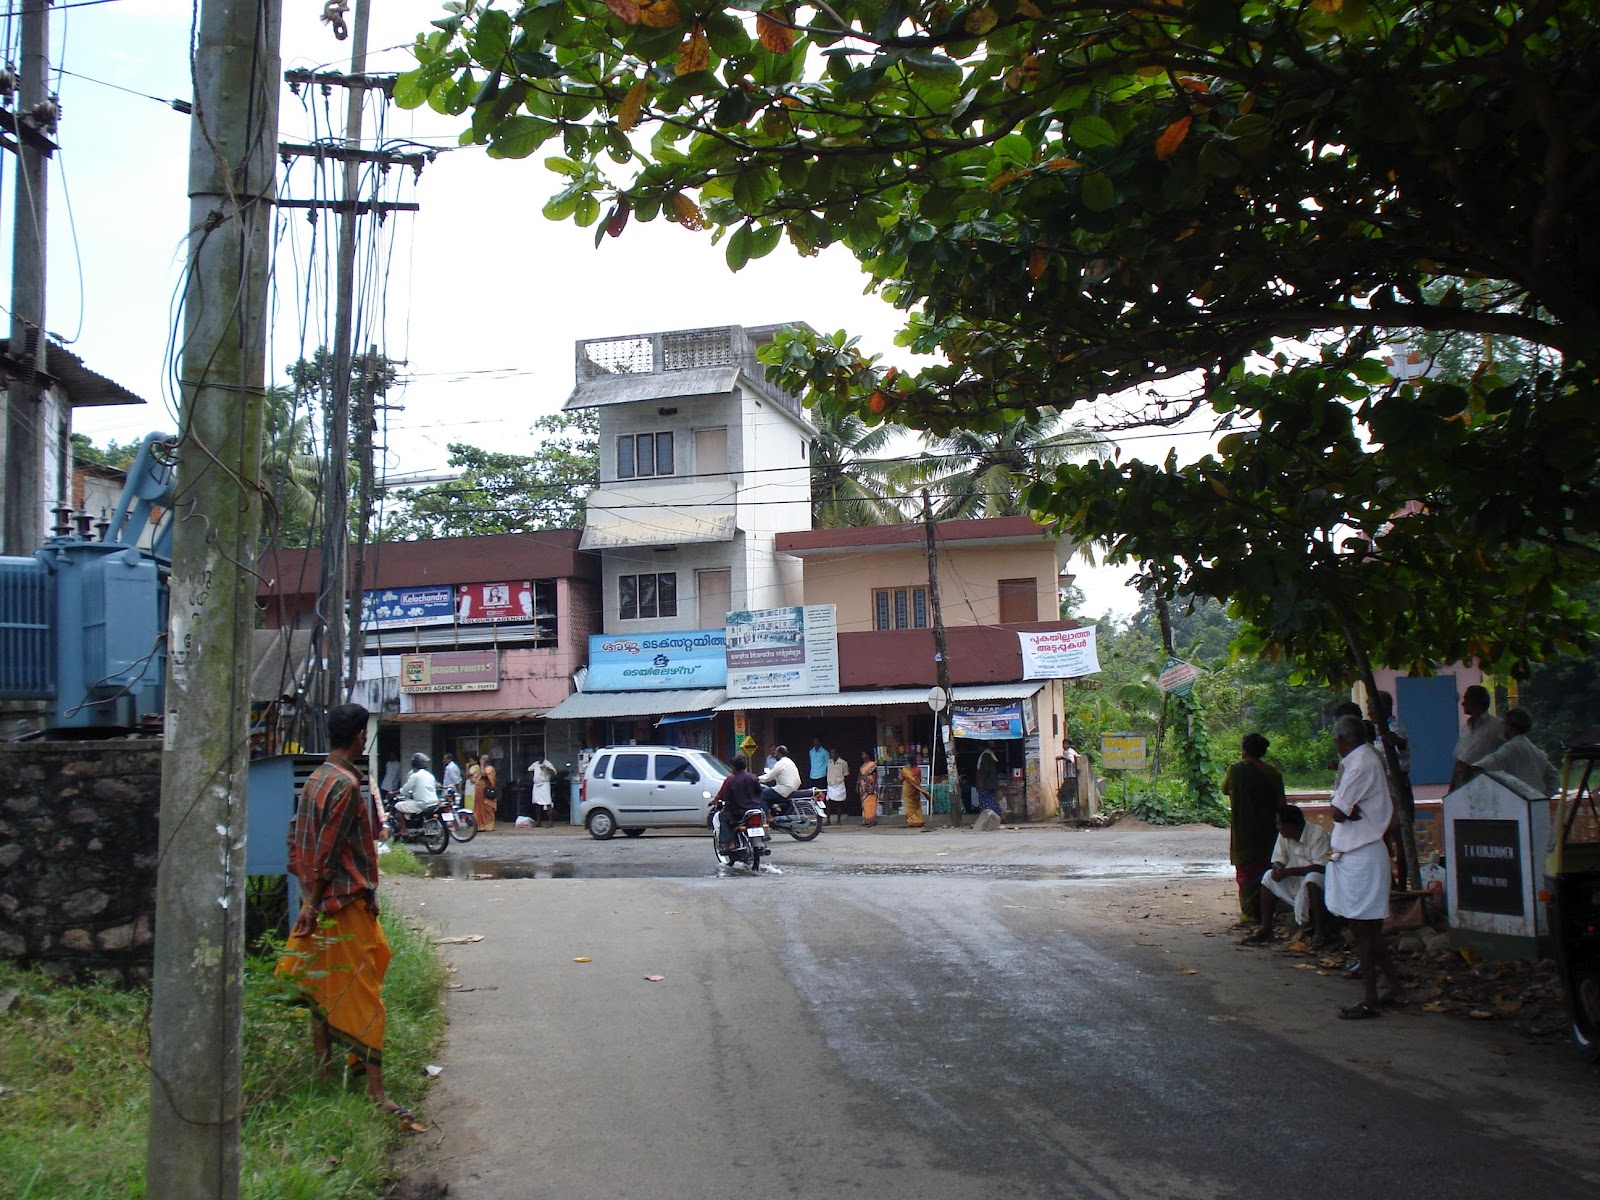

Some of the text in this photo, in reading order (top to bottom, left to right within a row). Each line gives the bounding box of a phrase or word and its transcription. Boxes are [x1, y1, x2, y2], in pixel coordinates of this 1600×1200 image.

[402, 591, 449, 604] Kelachandra
[496, 615, 532, 623] AGENCIES
[430, 664, 486, 675] BERGER PAINTS
